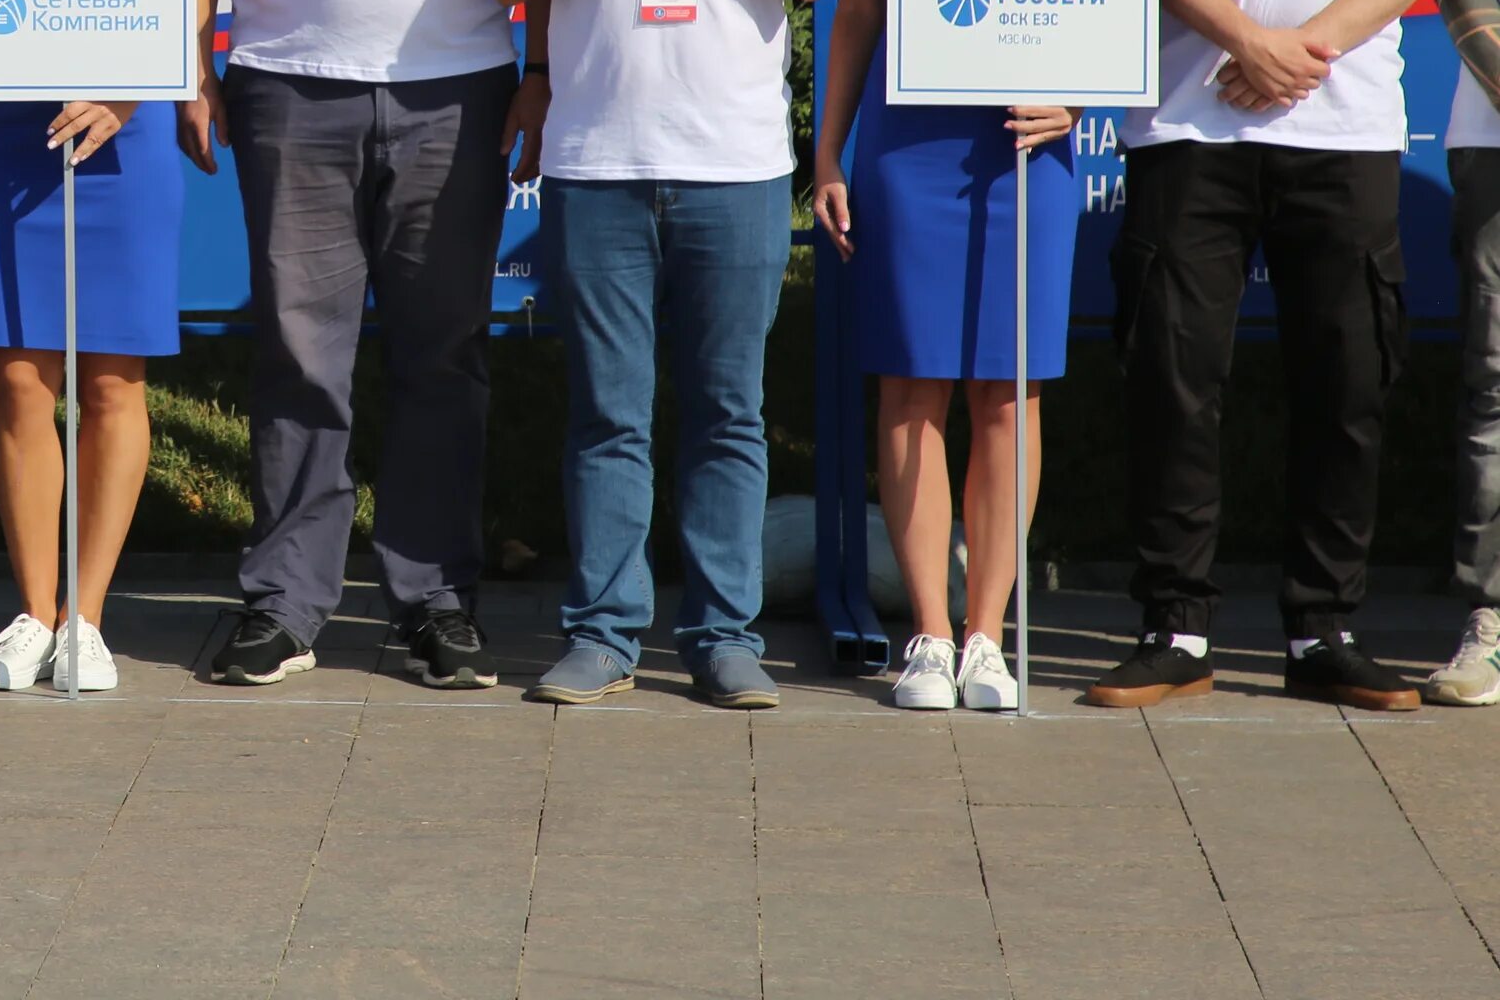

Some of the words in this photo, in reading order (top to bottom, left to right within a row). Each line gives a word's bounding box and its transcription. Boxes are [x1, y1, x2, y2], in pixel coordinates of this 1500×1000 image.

[32, 11, 160, 31] Компания
[999, 12, 1028, 26] ФСК
[1033, 12, 1058, 26] ЕЭС
[998, 34, 1021, 45] МЭС
[1022, 34, 1041, 45] Юга
